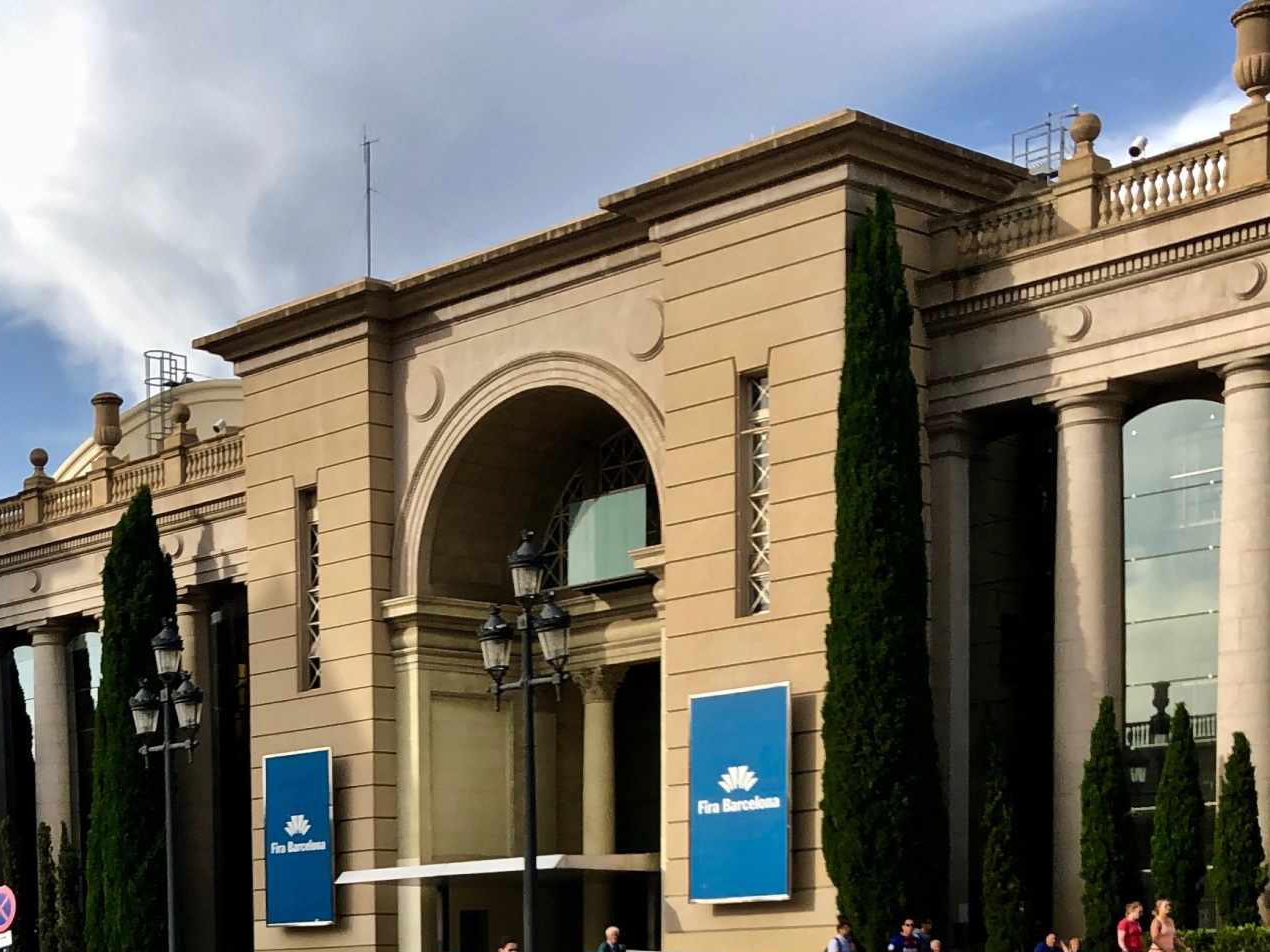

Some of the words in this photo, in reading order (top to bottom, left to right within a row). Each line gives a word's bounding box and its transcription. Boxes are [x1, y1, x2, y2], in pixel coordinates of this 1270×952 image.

[697, 799, 720, 815] Fira
[722, 795, 781, 813] Barcelona
[270, 842, 286, 854] Fira
[287, 839, 327, 853] Barcelona
